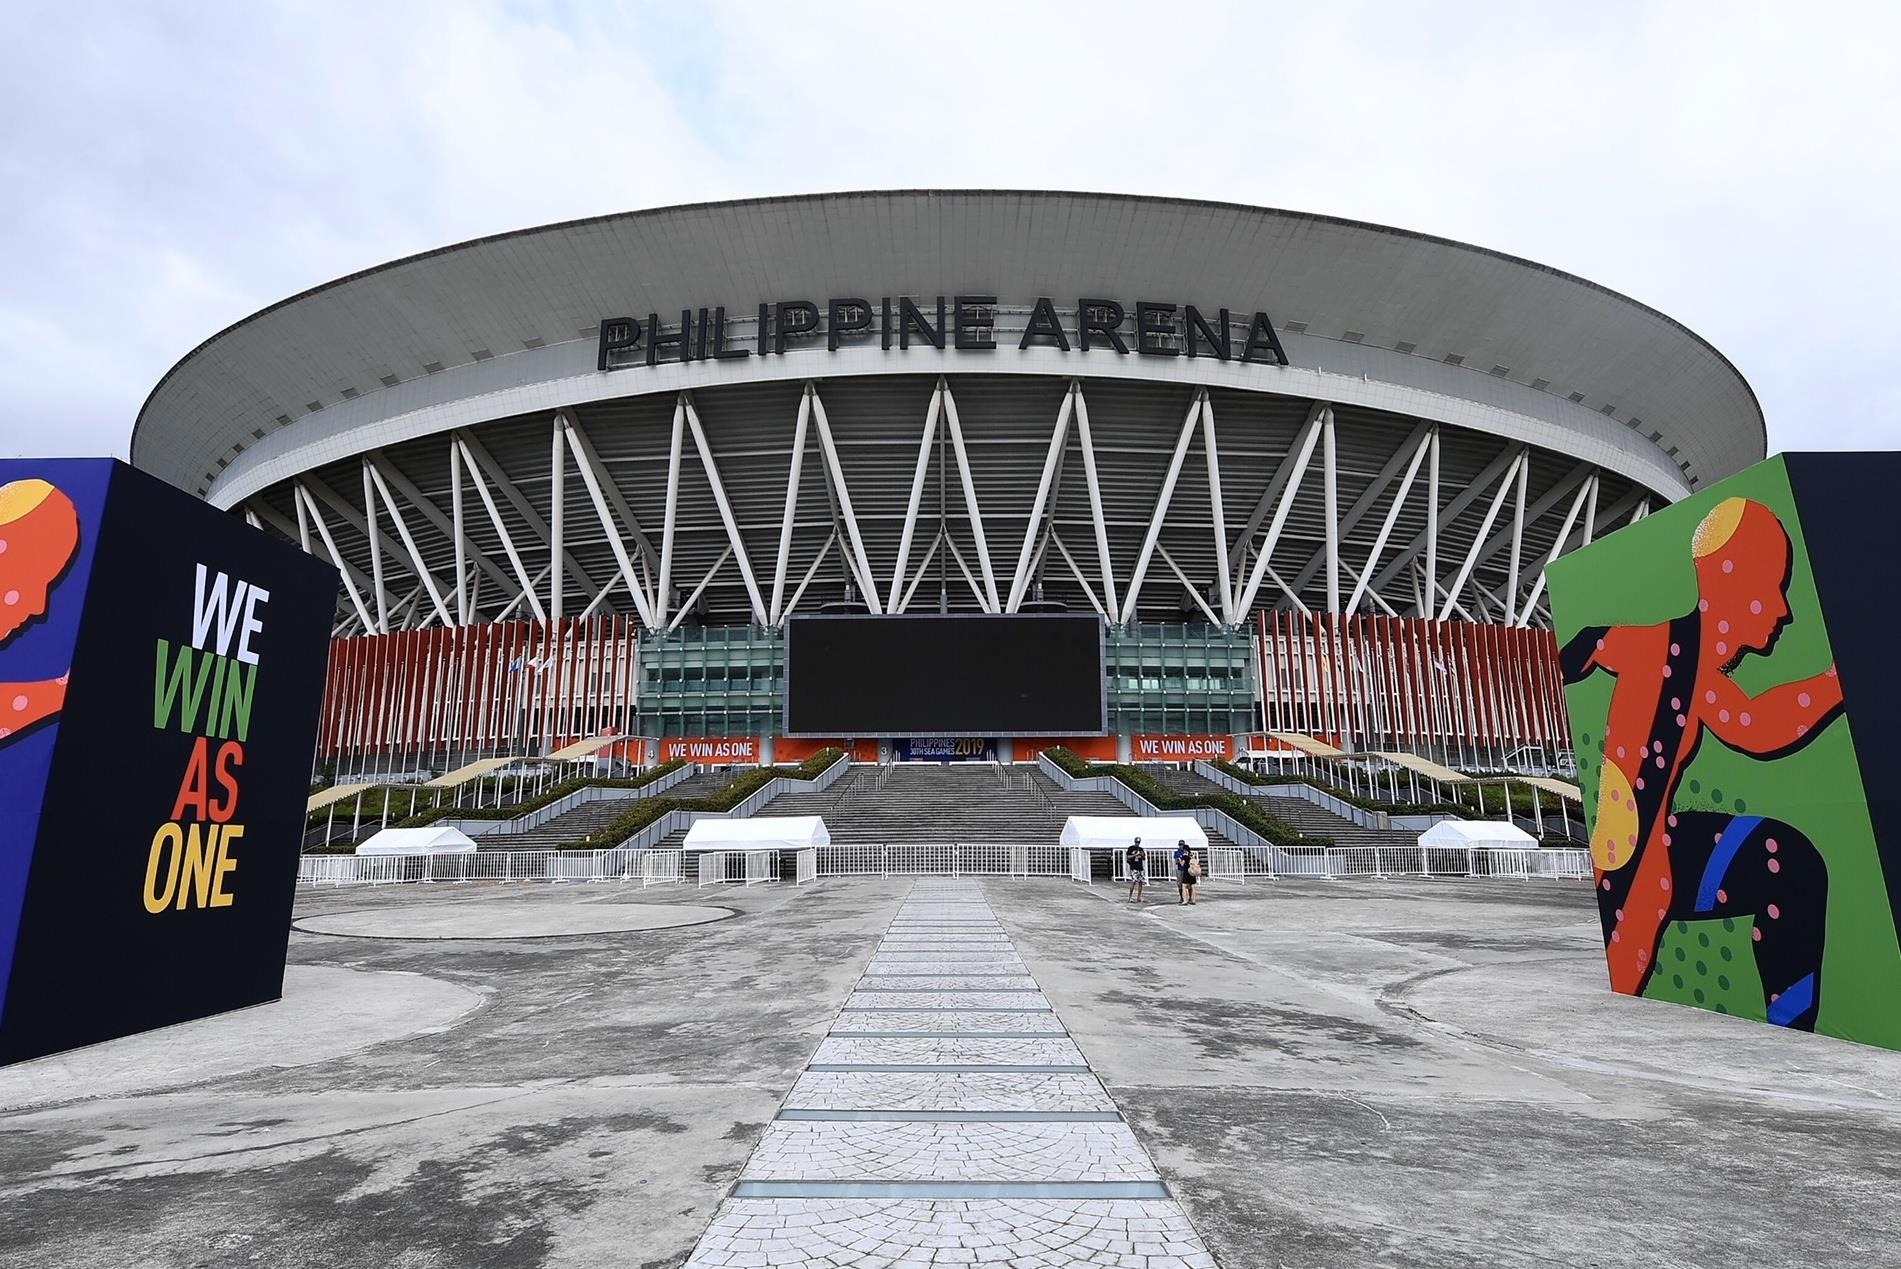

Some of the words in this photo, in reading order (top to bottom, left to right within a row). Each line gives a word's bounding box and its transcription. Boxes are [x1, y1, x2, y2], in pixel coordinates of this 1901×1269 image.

[597, 295, 998, 371] PHILIPPINE
[1018, 297, 1289, 367] ARENA
[191, 562, 270, 666] WE
[153, 638, 258, 743] WIN
[669, 743, 686, 757] WE
[689, 743, 713, 757] WIN
[714, 743, 730, 756] AS
[731, 742, 752, 756] ONE
[881, 746, 888, 755] 3
[910, 738, 956, 748] PHILIPPINES
[955, 738, 984, 755] 2019
[1140, 740, 1159, 754] WE
[1161, 740, 1186, 754] WIN
[1187, 740, 1203, 754] AS
[1204, 740, 1225, 754] ONE
[647, 750, 655, 759] 4
[923, 747, 935, 756] SEA
[935, 747, 955, 756] GAMES
[169, 736, 244, 823] AS
[143, 821, 245, 914] ONE
